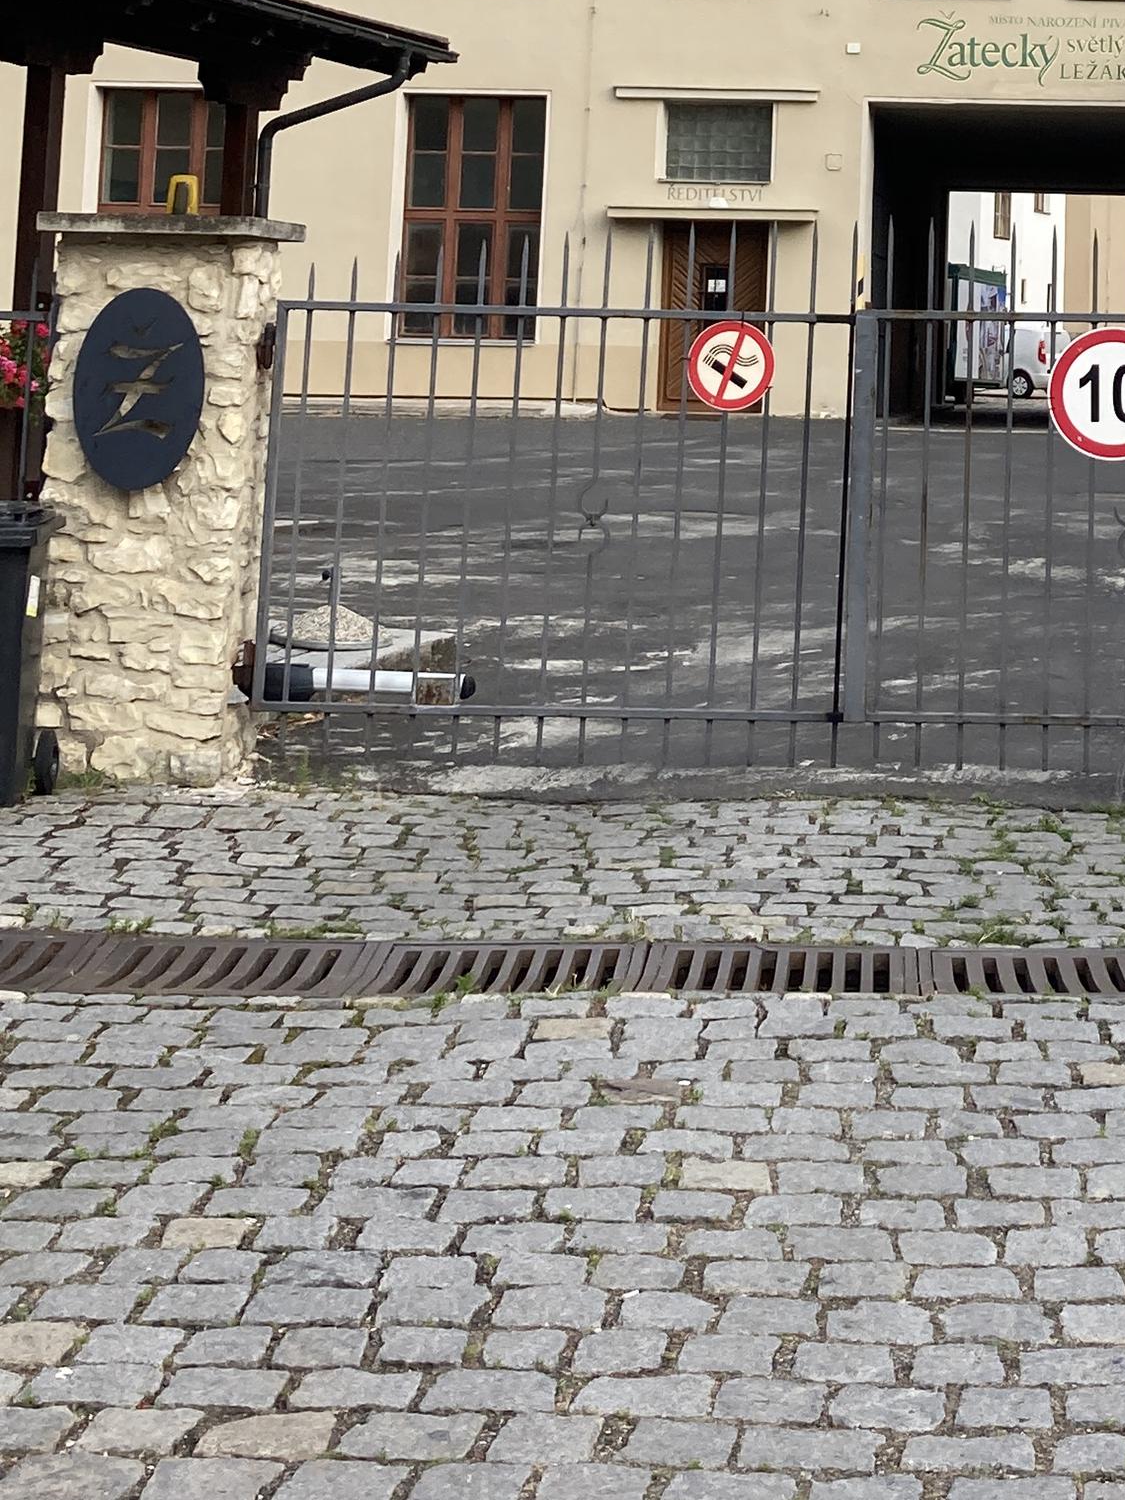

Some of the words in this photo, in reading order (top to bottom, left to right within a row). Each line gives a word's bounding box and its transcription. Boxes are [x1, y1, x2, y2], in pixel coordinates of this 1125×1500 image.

[1027, 14, 1098, 29] NAROZENÍ
[916, 10, 1060, 87] Žatecký
[1067, 35, 1124, 59] světlý
